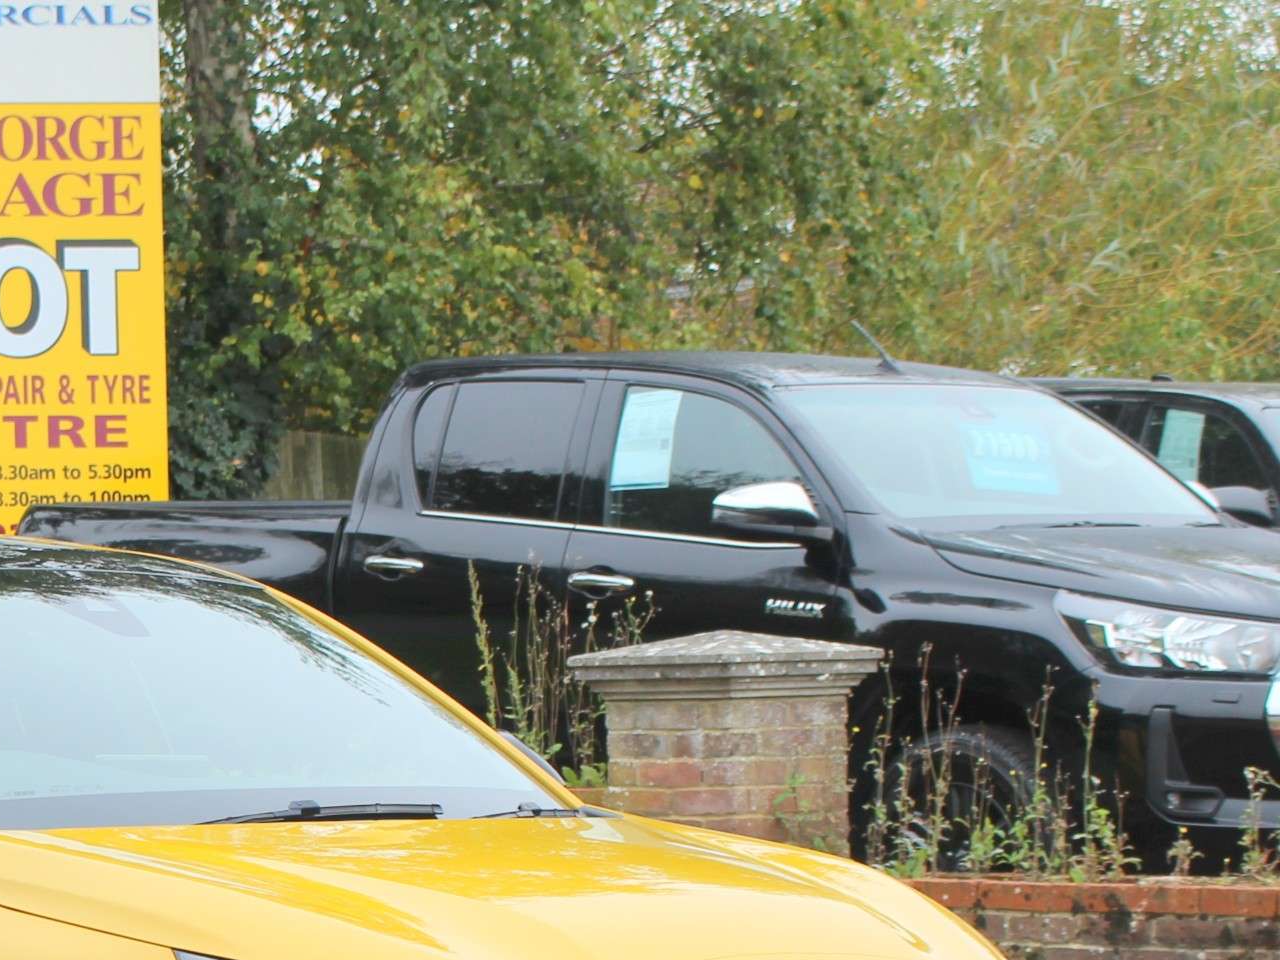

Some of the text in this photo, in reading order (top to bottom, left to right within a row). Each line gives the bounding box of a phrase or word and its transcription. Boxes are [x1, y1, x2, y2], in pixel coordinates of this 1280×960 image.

[58, 374, 75, 405] &
[86, 374, 152, 405] TYRE
[63, 465, 81, 480] to
[88, 464, 151, 483] 5.30pm
[63, 492, 81, 503] to
[89, 491, 151, 502] 100m
